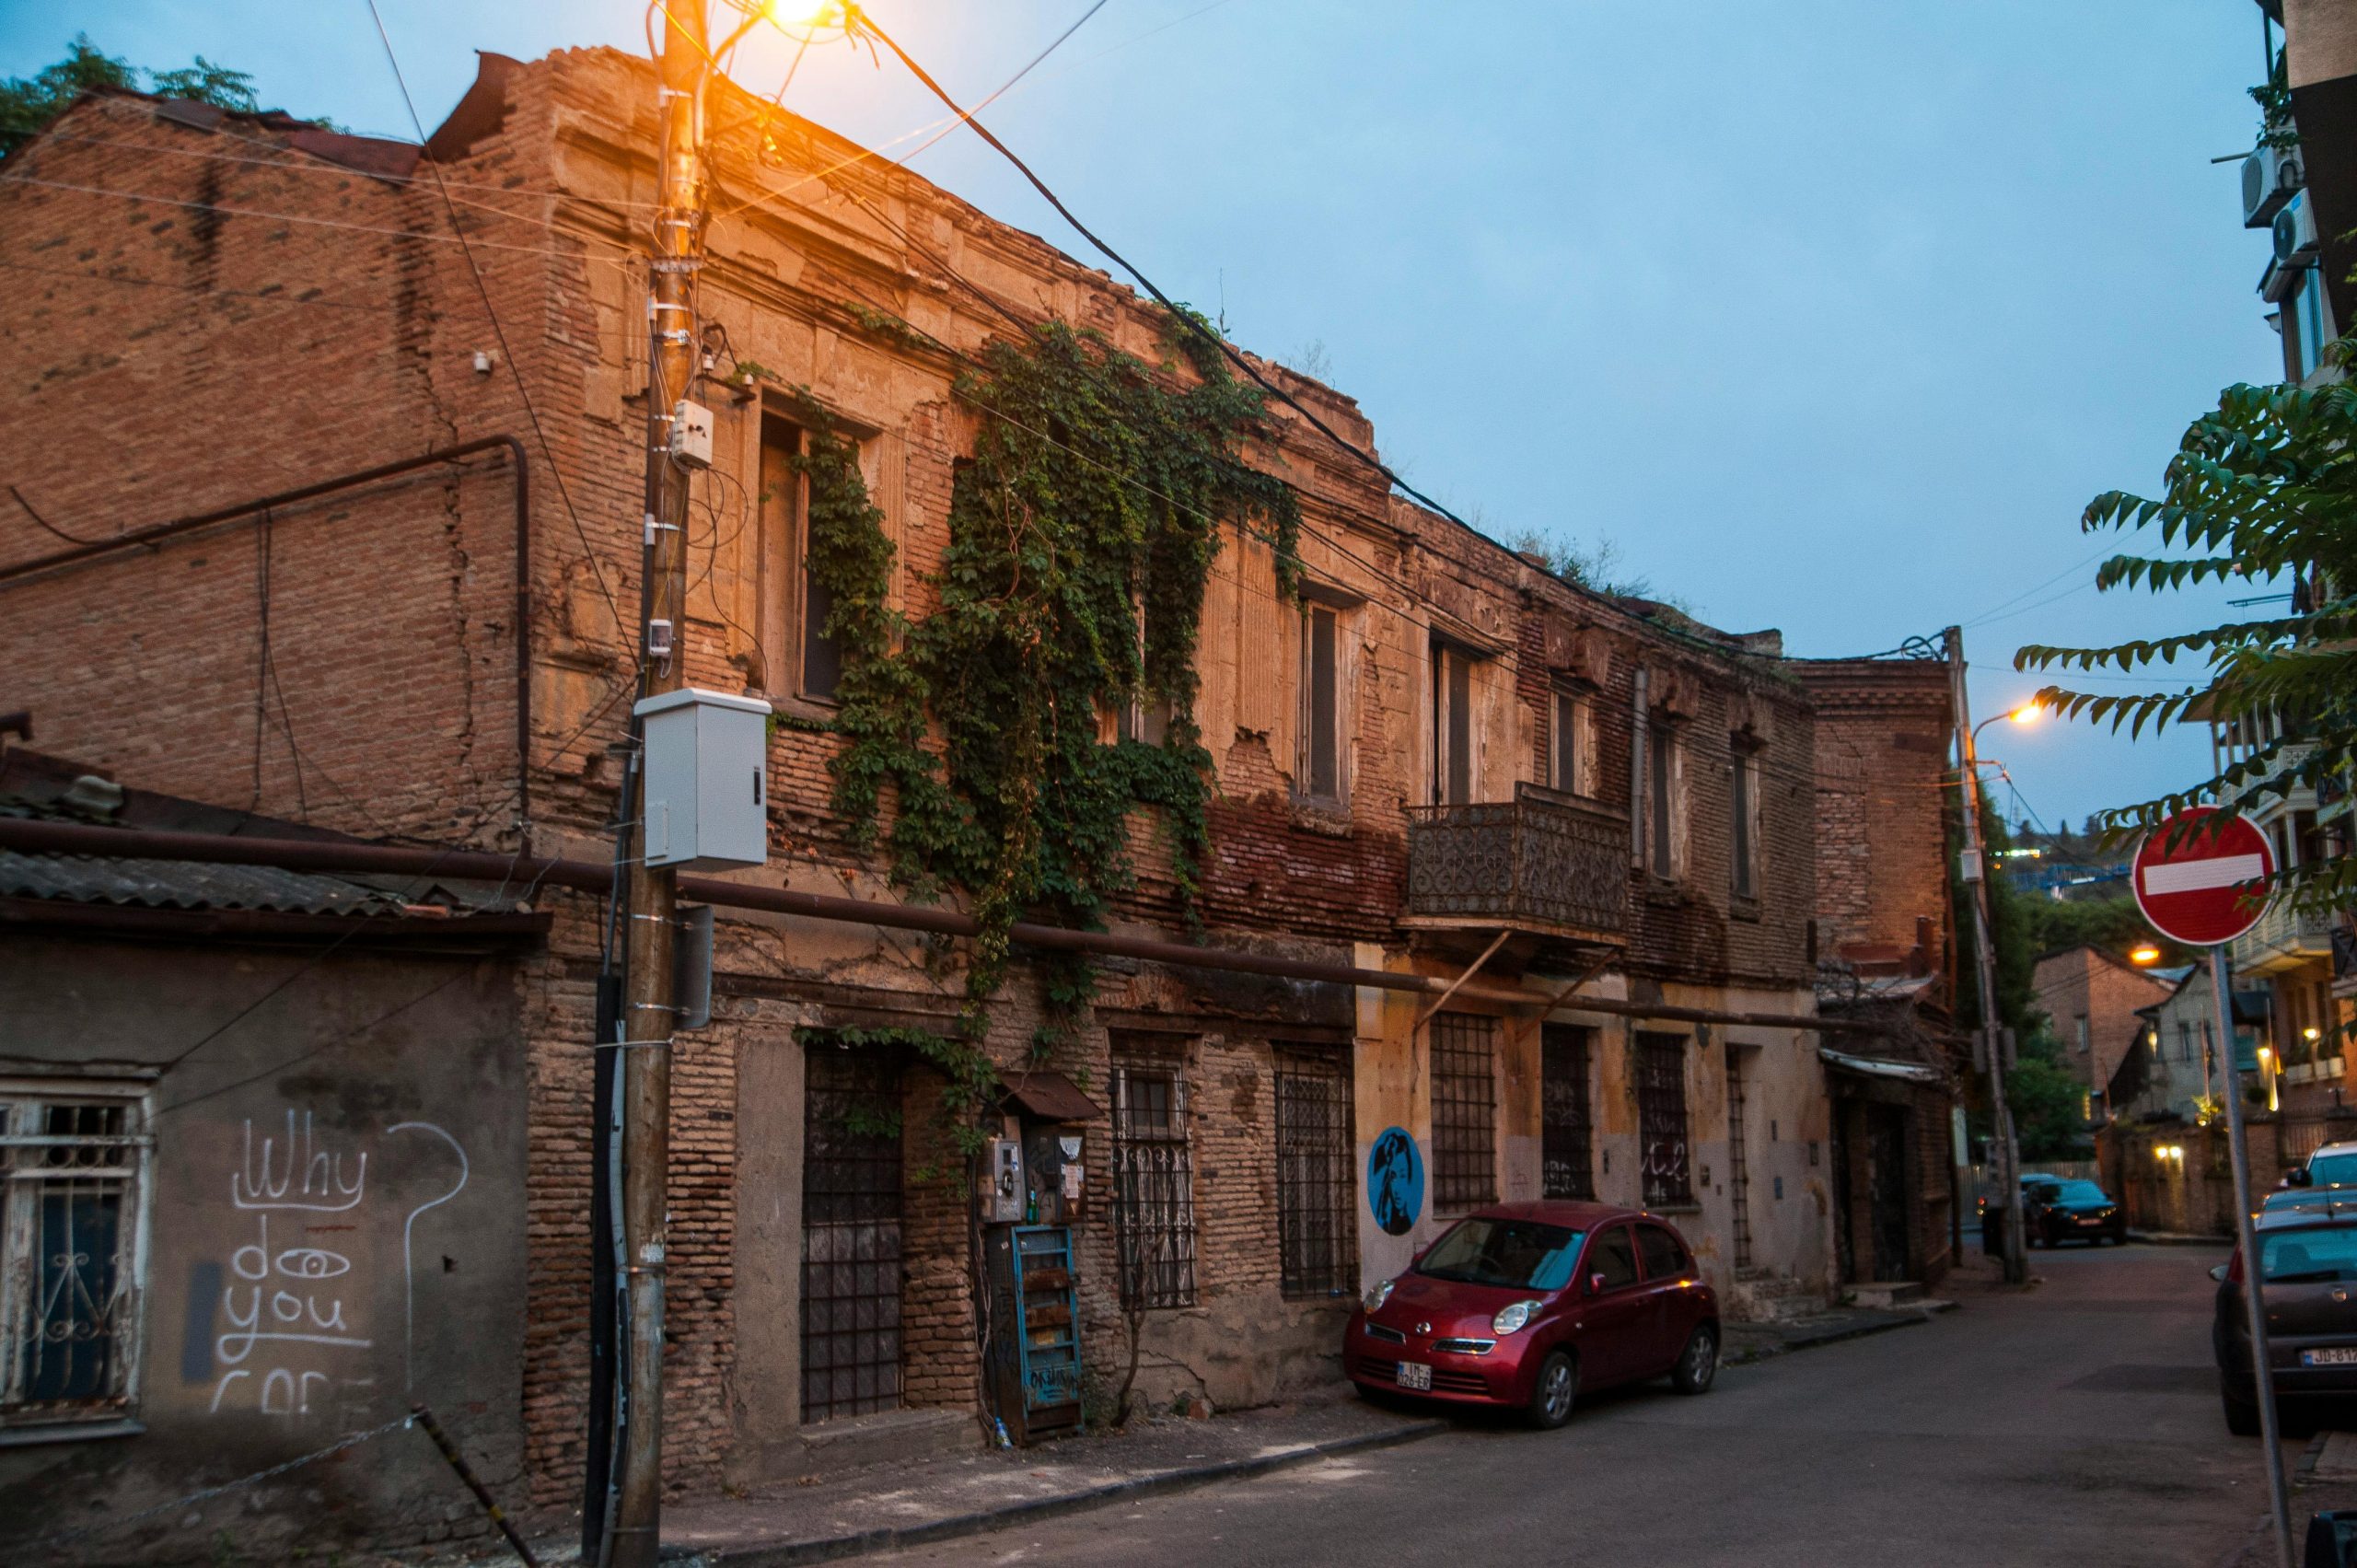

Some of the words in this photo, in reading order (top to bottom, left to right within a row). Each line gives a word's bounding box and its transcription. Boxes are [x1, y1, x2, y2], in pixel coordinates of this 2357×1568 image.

[231, 1109, 367, 1210] Why
[231, 1214, 351, 1281] do
[216, 1286, 372, 1364] you
